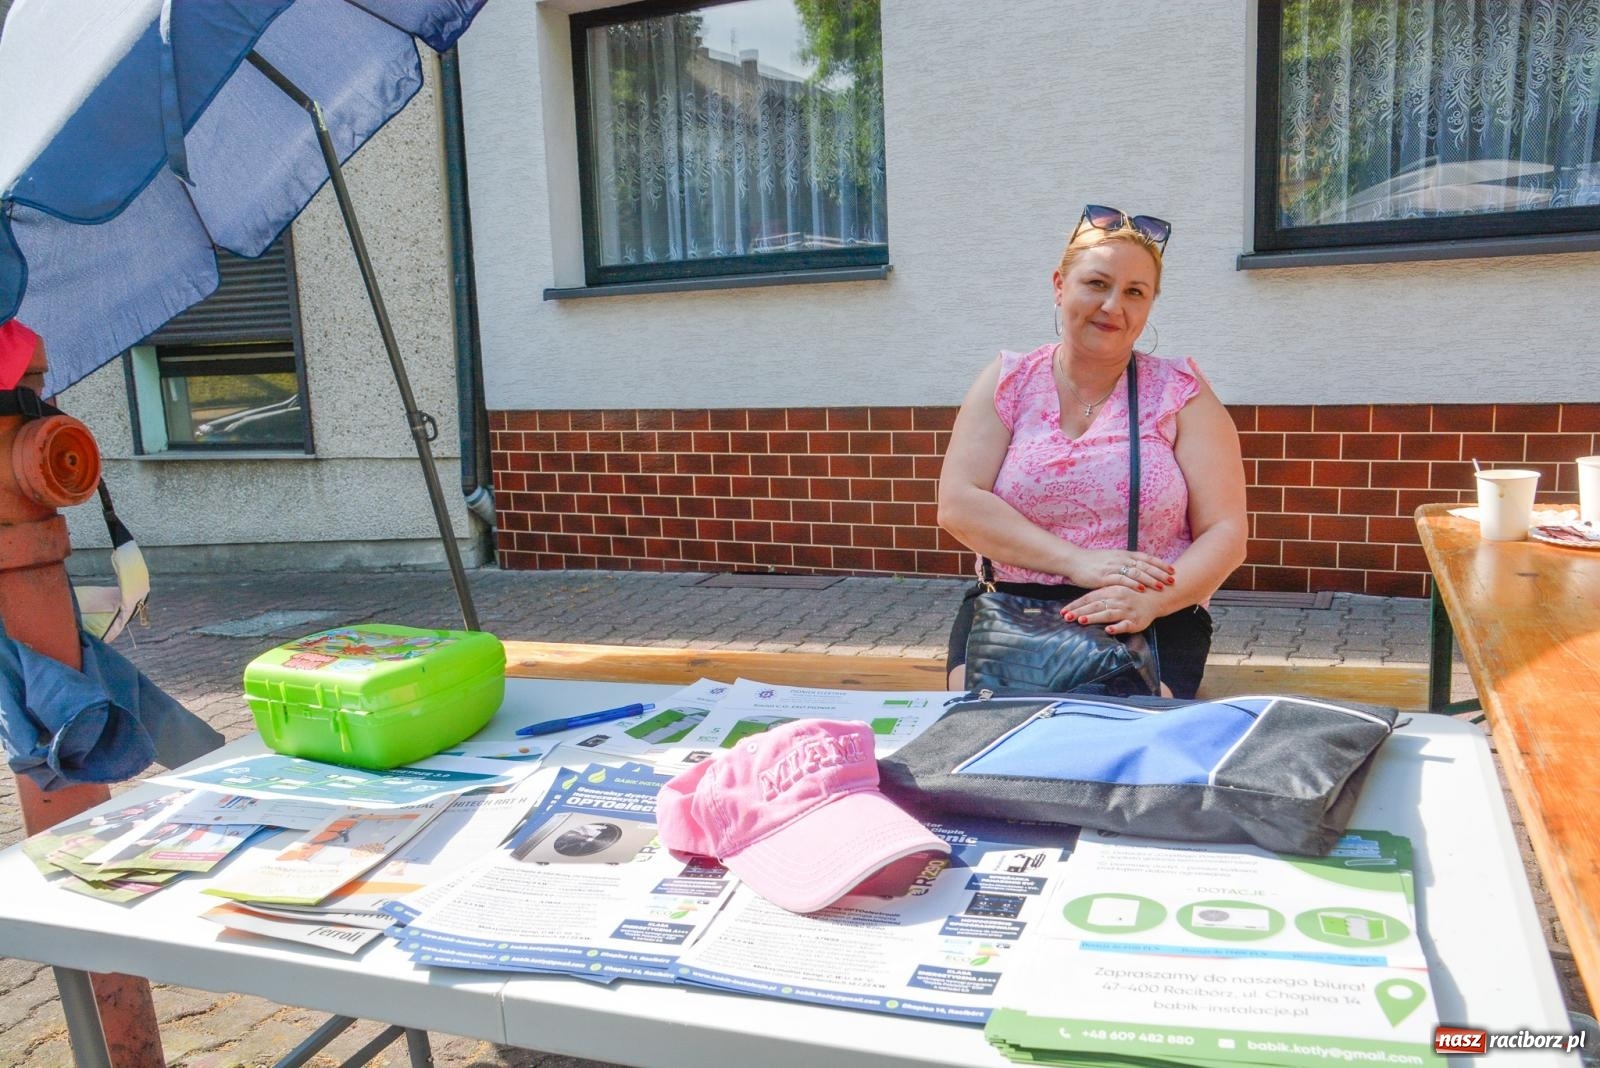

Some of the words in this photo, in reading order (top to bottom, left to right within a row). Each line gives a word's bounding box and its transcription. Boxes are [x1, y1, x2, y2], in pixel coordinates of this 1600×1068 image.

[758, 732, 866, 802] MIAMI
[937, 834, 979, 844] onic
[307, 926, 366, 943] Ferroli
[1094, 967, 1198, 982] Zapraszamy
[1203, 974, 1227, 984] do
[1231, 976, 1309, 988] naszego
[1312, 978, 1366, 992] biura!
[1101, 981, 1160, 994] 47-400
[1264, 989, 1340, 1004] Chopina
[1153, 1000, 1310, 1017] babik-instalacje.pl
[1082, 1029, 1107, 1041] +48
[1109, 1031, 1136, 1042] 609
[1138, 1033, 1165, 1045] 482
[1167, 1035, 1195, 1047] 880
